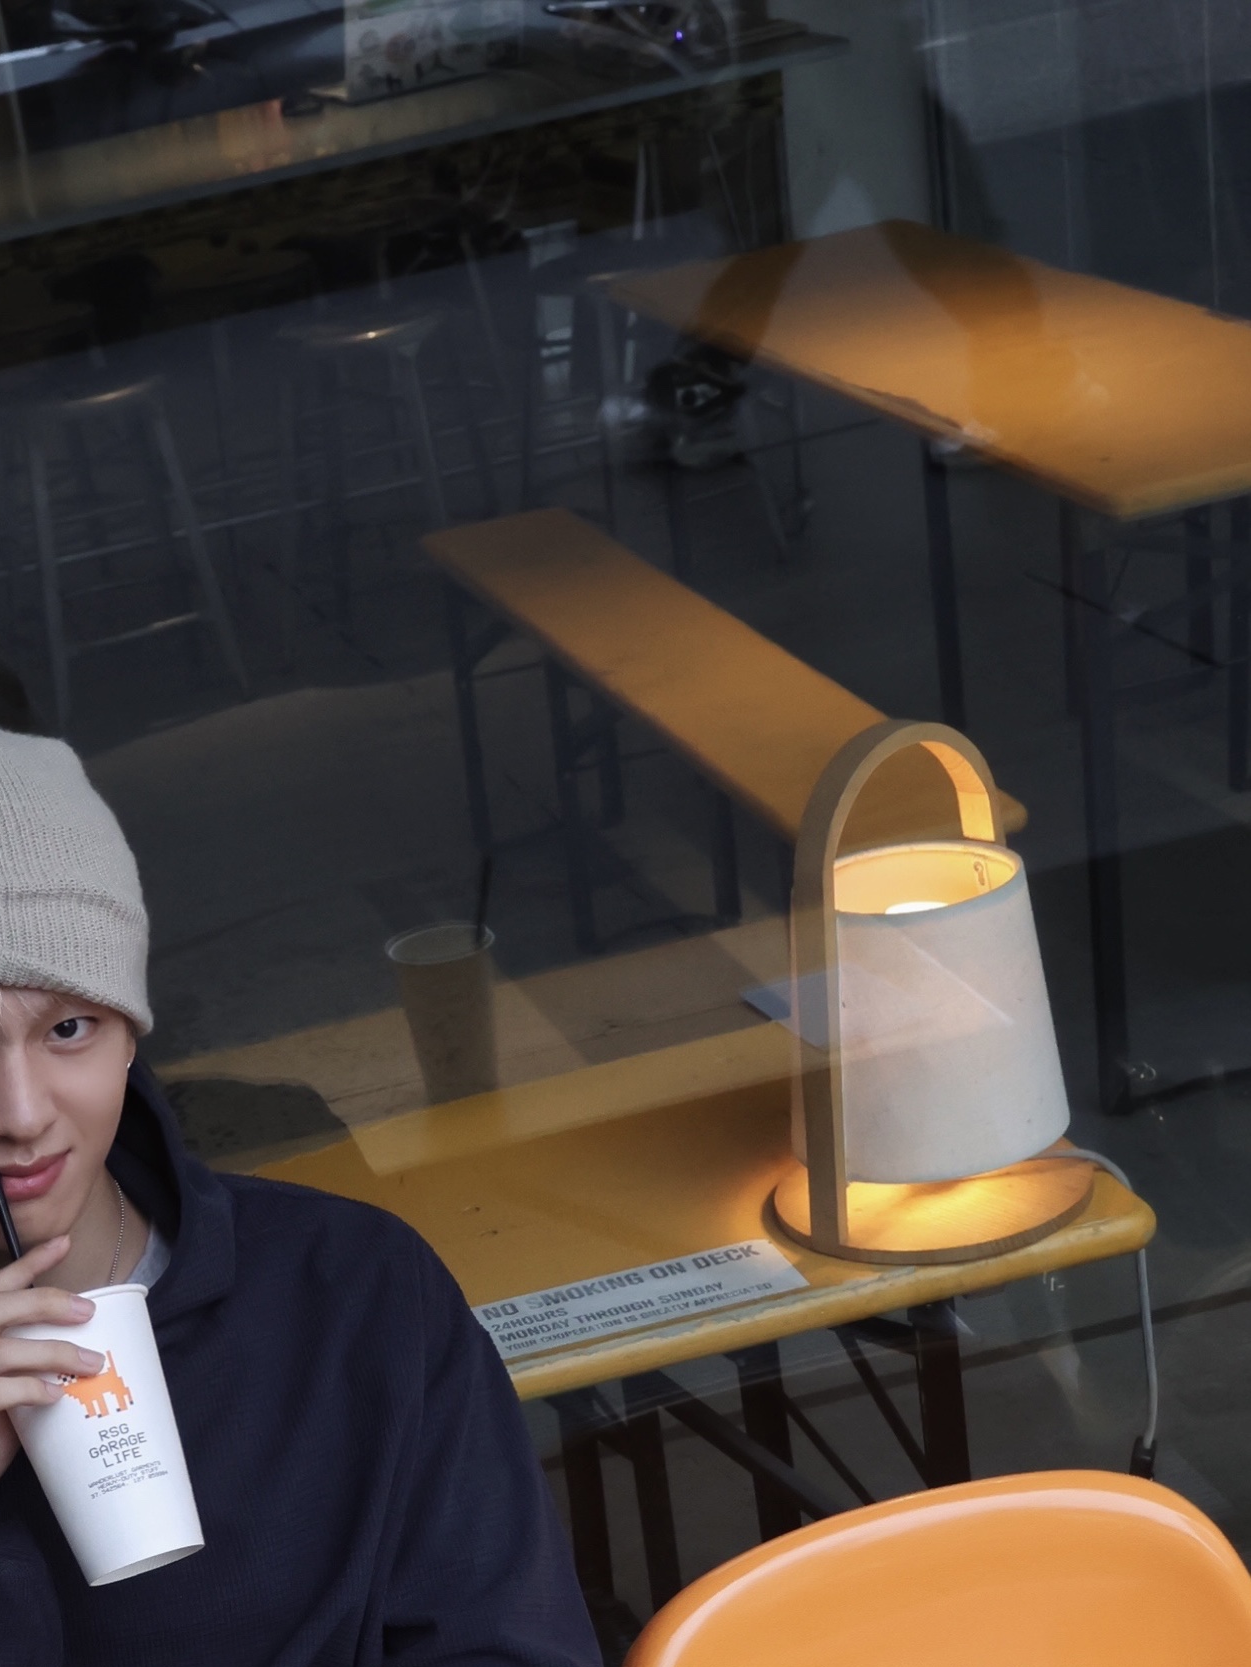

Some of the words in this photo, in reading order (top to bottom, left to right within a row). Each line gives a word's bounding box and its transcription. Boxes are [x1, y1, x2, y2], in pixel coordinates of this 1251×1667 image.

[482, 1302, 519, 1321] NO
[525, 1272, 645, 1309] SMOKING
[649, 1262, 687, 1279] ON
[692, 1245, 760, 1270] DECK
[491, 1307, 568, 1333] 24HOURS
[498, 1319, 570, 1343] MONDAY
[574, 1299, 654, 1324] THROUGH
[658, 1282, 723, 1304] SUNDAY
[505, 1339, 537, 1351] YOUR
[625, 1313, 638, 1323] IS
[89, 1432, 147, 1459] GARAGE
[98, 1423, 129, 1441] RSG
[103, 1446, 142, 1468] LIFE
